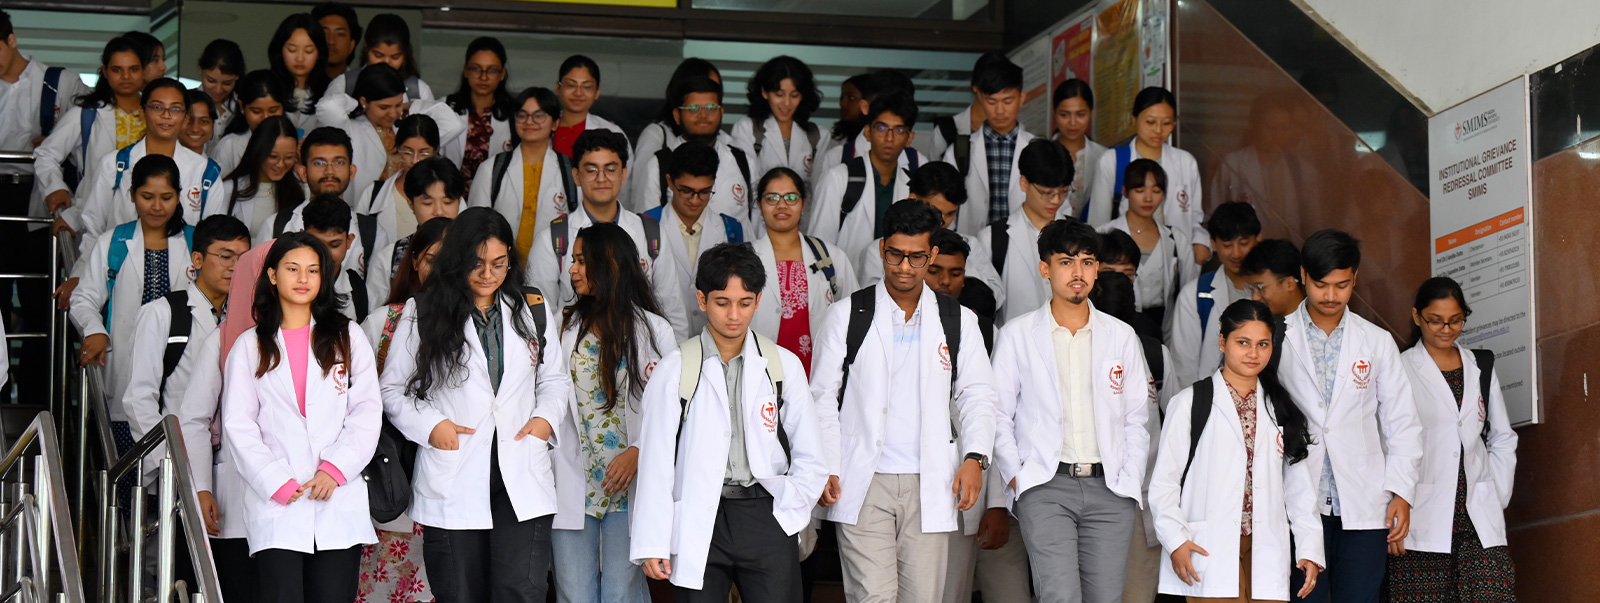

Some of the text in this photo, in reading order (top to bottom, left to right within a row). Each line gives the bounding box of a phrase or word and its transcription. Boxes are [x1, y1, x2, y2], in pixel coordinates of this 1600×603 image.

[1462, 111, 1488, 136] SMIMS
[1438, 139, 1517, 181] INSTITUTIONAL GRIEVANCE
[1442, 156, 1513, 195] REDRESSAL COMMITTEE
[1468, 183, 1488, 200] SMIMS
